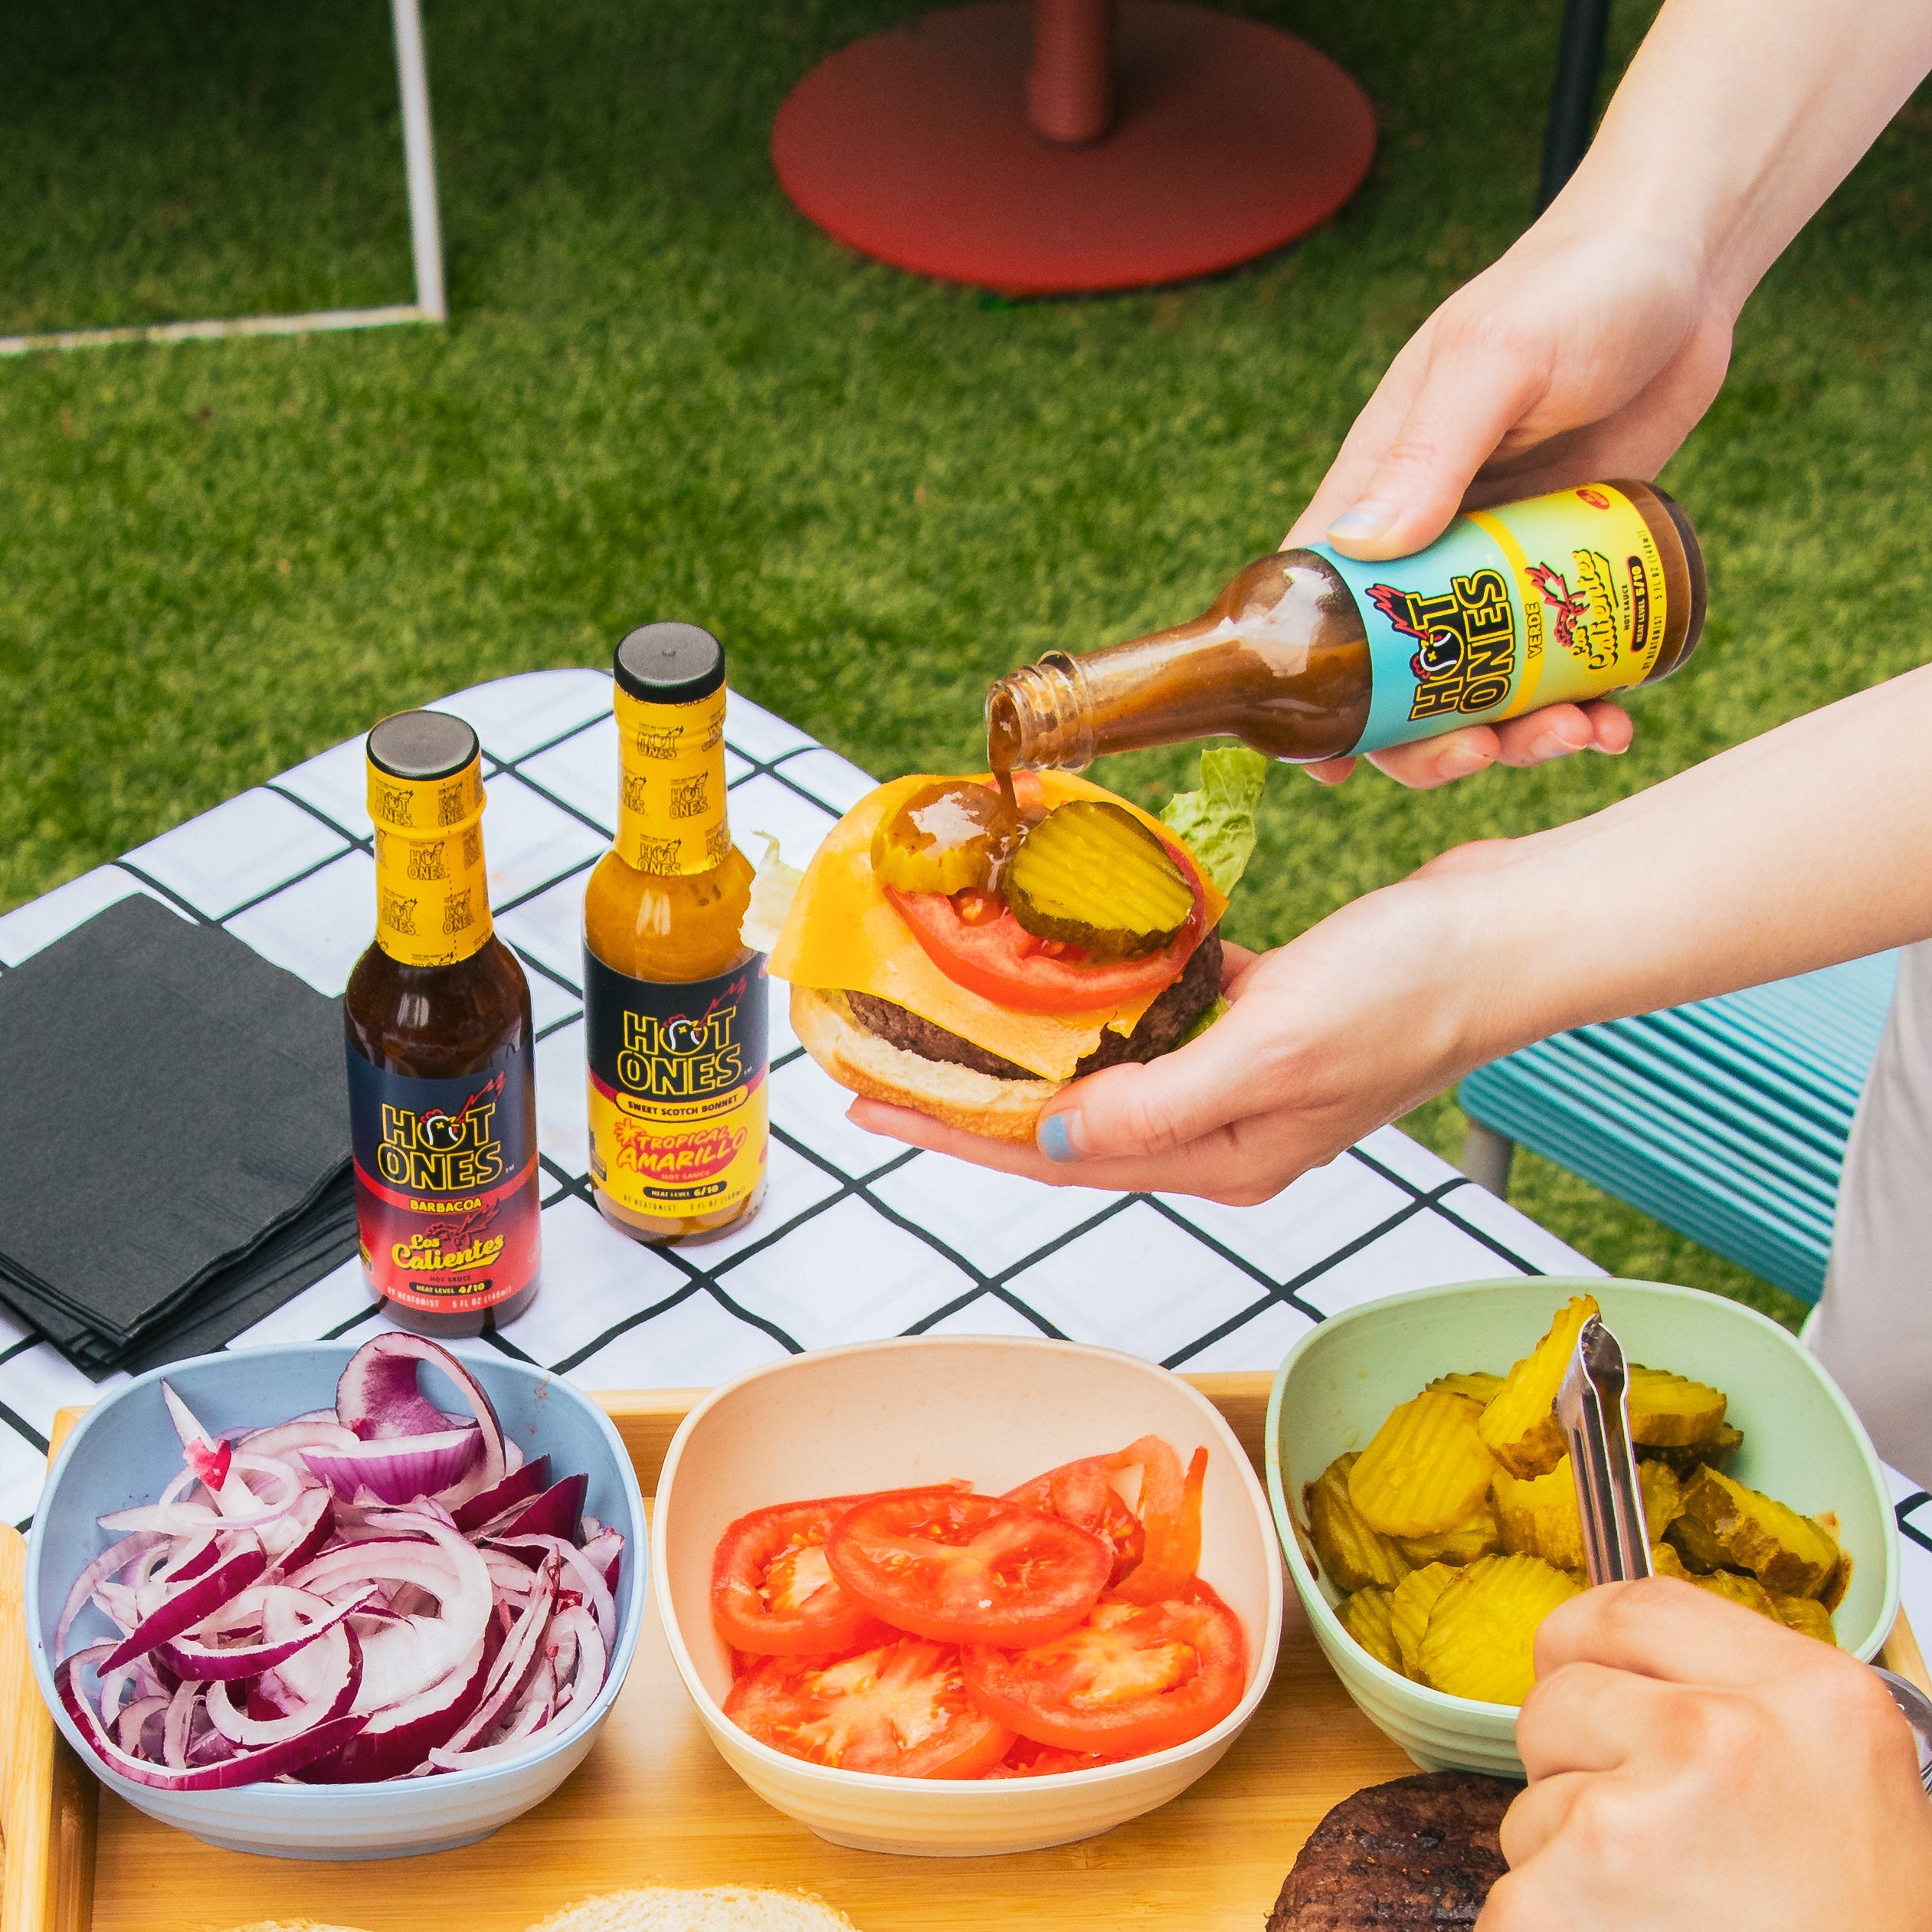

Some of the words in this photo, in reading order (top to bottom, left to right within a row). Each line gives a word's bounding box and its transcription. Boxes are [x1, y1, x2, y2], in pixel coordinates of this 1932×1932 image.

[1631, 565, 1645, 597] 5/10
[1653, 581, 1662, 591] FL
[1571, 548, 1619, 670] Calientes
[1622, 585, 1630, 610] SAUCE
[1452, 569, 1515, 714] ONES
[1524, 601, 1543, 660] VERDE
[1571, 624, 1593, 659] Los
[1636, 624, 1645, 643] HEAT
[1405, 592, 1465, 722] HOT
[670, 797, 708, 820] ONES
[410, 849, 442, 865] HOT
[640, 842, 677, 863] HOT
[408, 863, 445, 881] ONES
[623, 1005, 738, 1056] HOT
[617, 1043, 742, 1095] ONES
[628, 1101, 658, 1115] SWEET
[661, 1108, 699, 1116] SCOTCH
[702, 1095, 738, 1112] BONNET
[381, 1102, 496, 1151] HOT
[637, 1125, 729, 1151] TROPICAL
[617, 1126, 748, 1173] AMARILLO
[378, 1141, 503, 1191] ONES
[682, 1171, 711, 1179] SAUCE
[693, 1184, 719, 1197] 6/10
[409, 1197, 482, 1213] BARBACOA
[391, 1234, 505, 1271] Calientes
[409, 1233, 441, 1250] Los
[398, 1291, 440, 1308] HEATONIST
[416, 1285, 433, 1293] HEAT
[458, 1282, 486, 1294] 4/10
